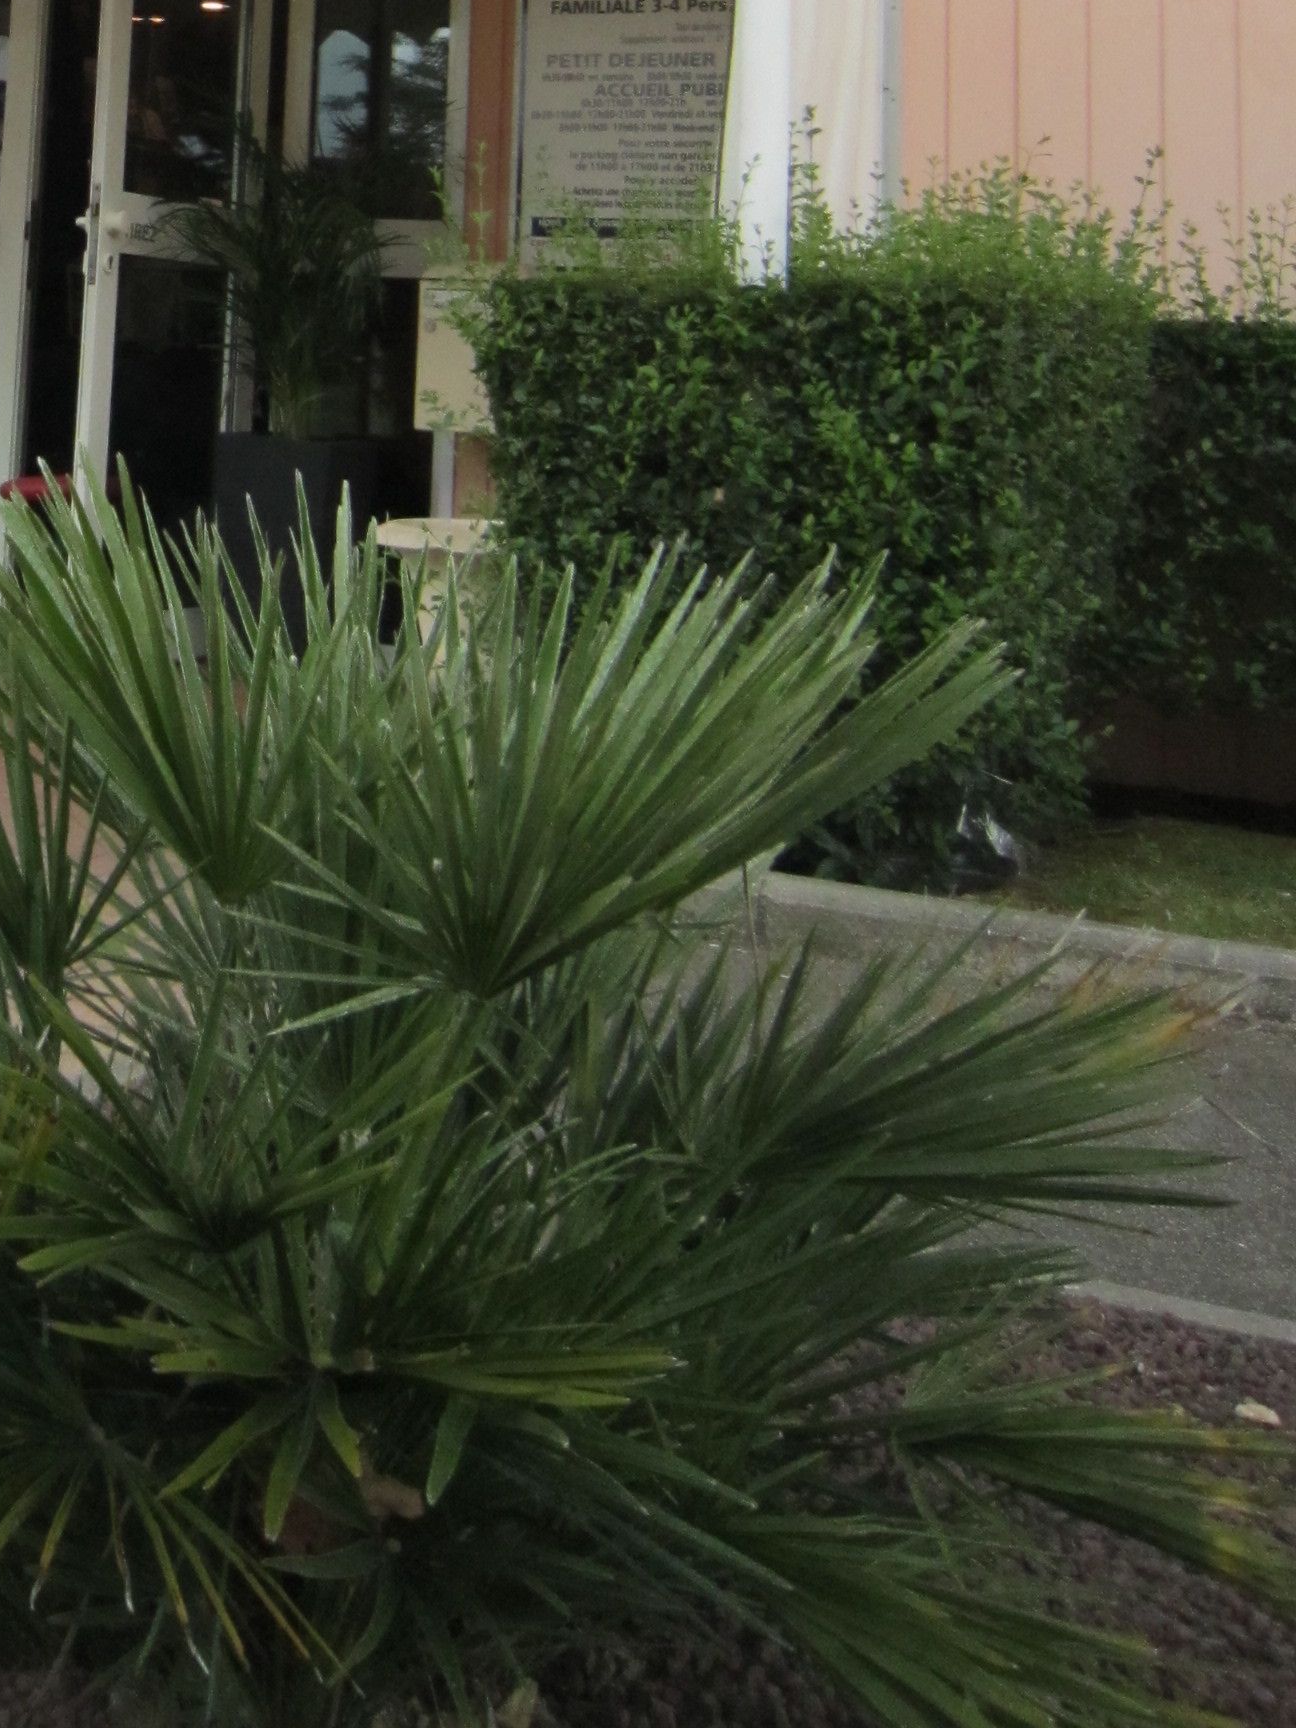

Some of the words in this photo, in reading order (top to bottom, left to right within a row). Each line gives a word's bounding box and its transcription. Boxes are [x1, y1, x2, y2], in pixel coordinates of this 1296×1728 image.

[545, 53, 602, 69] PETIT
[608, 51, 715, 68] DEJEUNER
[594, 83, 672, 97] ACCUEIL
